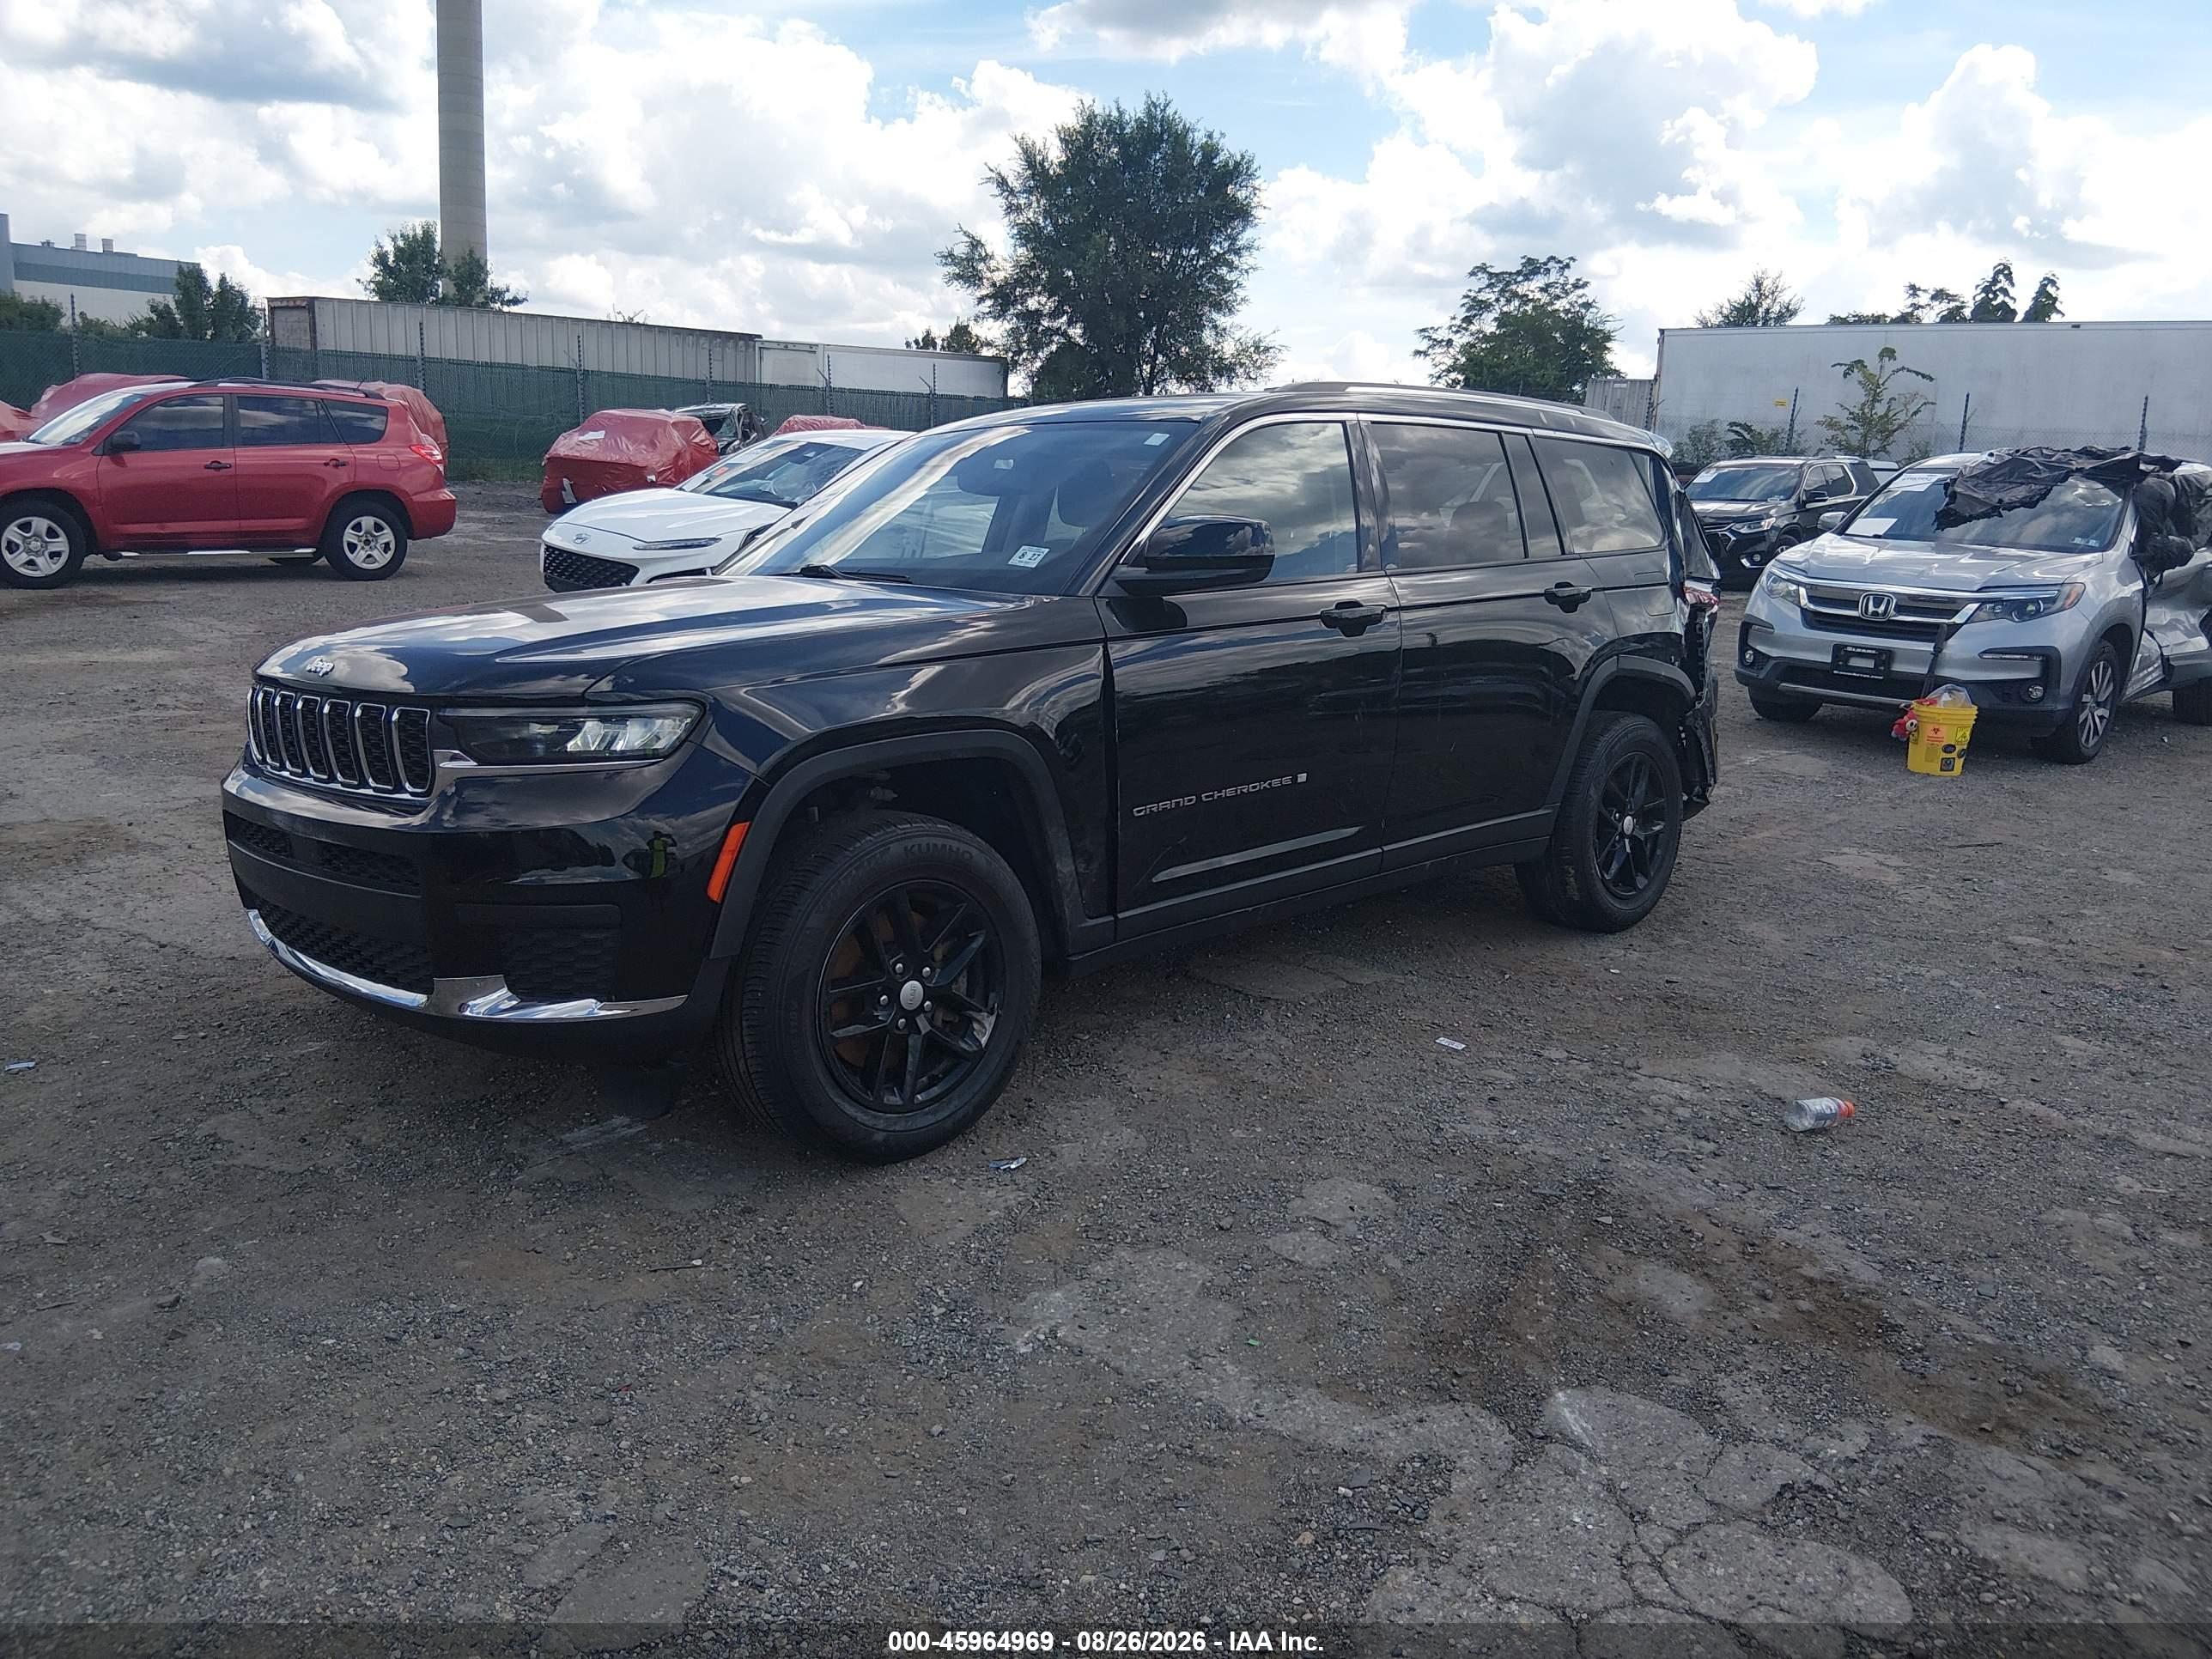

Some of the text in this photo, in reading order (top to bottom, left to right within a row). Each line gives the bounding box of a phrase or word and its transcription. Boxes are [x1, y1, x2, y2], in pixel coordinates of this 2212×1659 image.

[1133, 795, 1196, 817] GRAND
[1201, 775, 1292, 802] CHEROKEE
[903, 842, 974, 860] KUMHO
